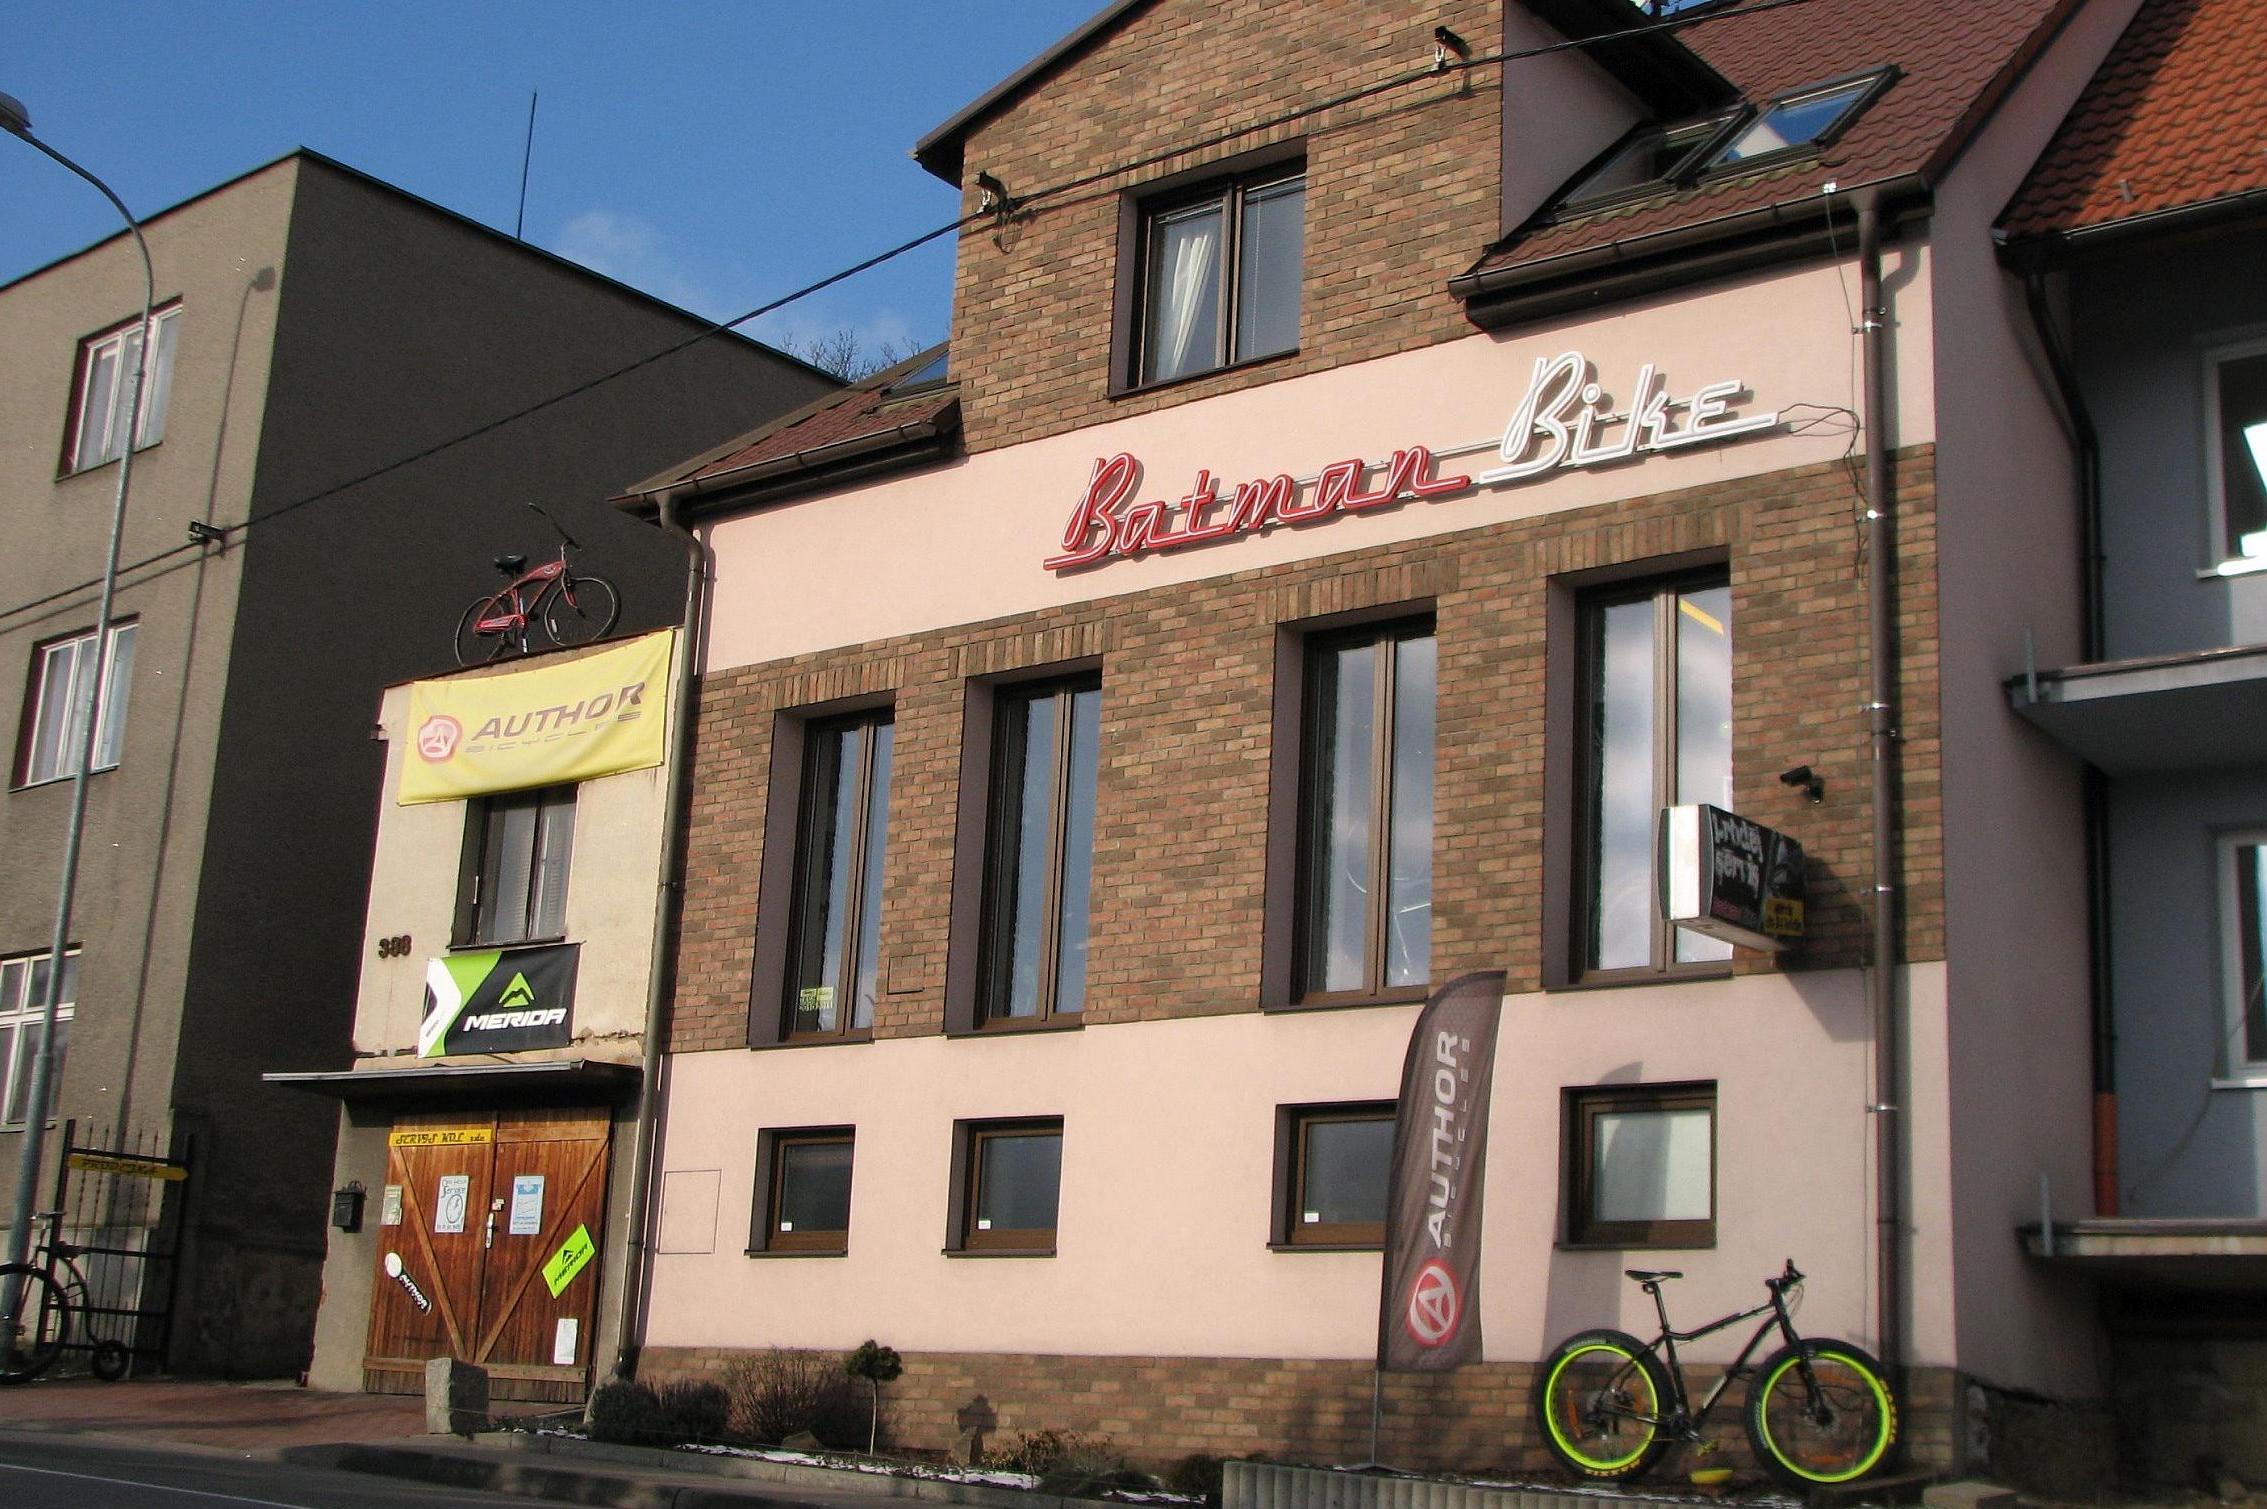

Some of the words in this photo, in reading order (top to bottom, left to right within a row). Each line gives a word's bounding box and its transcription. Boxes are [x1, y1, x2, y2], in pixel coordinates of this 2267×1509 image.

[1043, 446, 1471, 571] Batman
[1479, 350, 1780, 484] Bike
[471, 682, 645, 741] AUTHOR
[463, 1008, 567, 1032] MERIDA
[1428, 1032, 1458, 1249] AUTHOR
